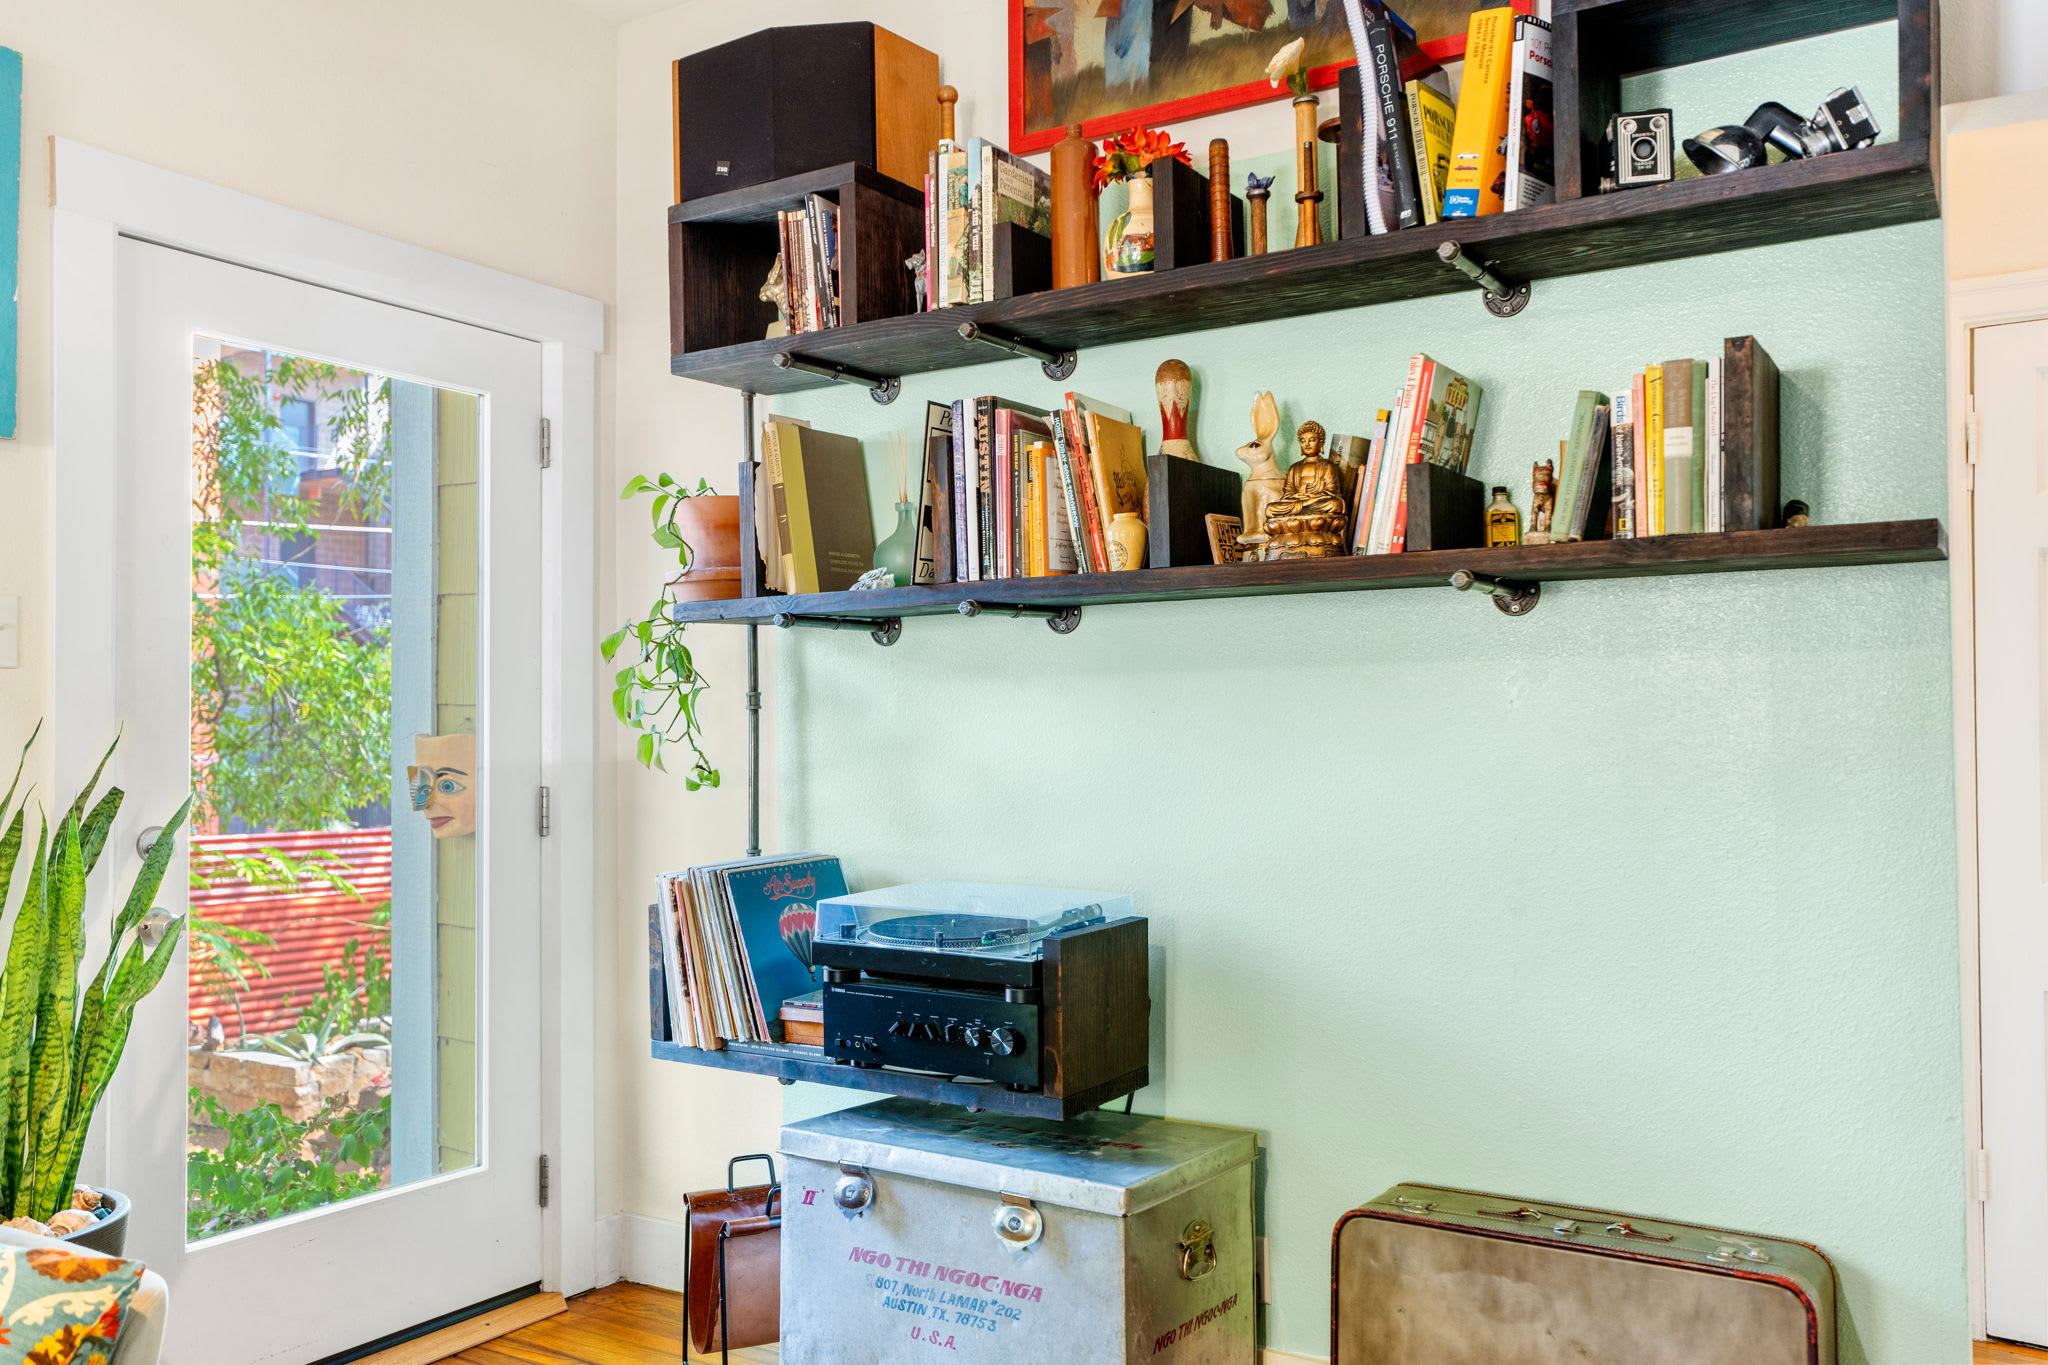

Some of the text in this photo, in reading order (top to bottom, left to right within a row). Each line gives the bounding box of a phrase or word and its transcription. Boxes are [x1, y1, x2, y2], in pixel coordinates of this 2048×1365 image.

[1479, 43, 1488, 69] Manual
[1374, 44, 1395, 115] PORSCHE
[1386, 117, 1398, 140] 911
[1409, 93, 1421, 128] PORSCHE
[1000, 162, 1033, 189] Gardening
[983, 174, 991, 216] Gardening
[1000, 178, 1033, 203] Perennials
[985, 237, 993, 279] Perennials
[1616, 395, 1626, 423] Birds
[1053, 416, 1063, 438] HOME
[1409, 431, 1420, 443] ALL
[977, 413, 991, 494] AUSTIN
[1057, 438, 1068, 462] TODAY
[1615, 434, 1625, 455] North
[1063, 463, 1071, 484] GONE
[1067, 399, 1079, 438] ALL
[1075, 442, 1090, 495] TORE
[1087, 502, 1095, 525] UP
[1615, 455, 1625, 486] America
[1067, 485, 1079, 528] TOMORROW
[818, 859, 838, 868] LOVE
[782, 869, 816, 897] Supply
[849, 1246, 892, 1269] NGO
[895, 1256, 931, 1278] THI
[902, 1282, 936, 1302] North
[938, 1290, 988, 1314] LAMAR
[954, 1311, 997, 1332] 78753
[910, 1326, 957, 1351] U.S.A.
[1153, 1328, 1177, 1355] NGO
[1179, 1318, 1194, 1341] THI
